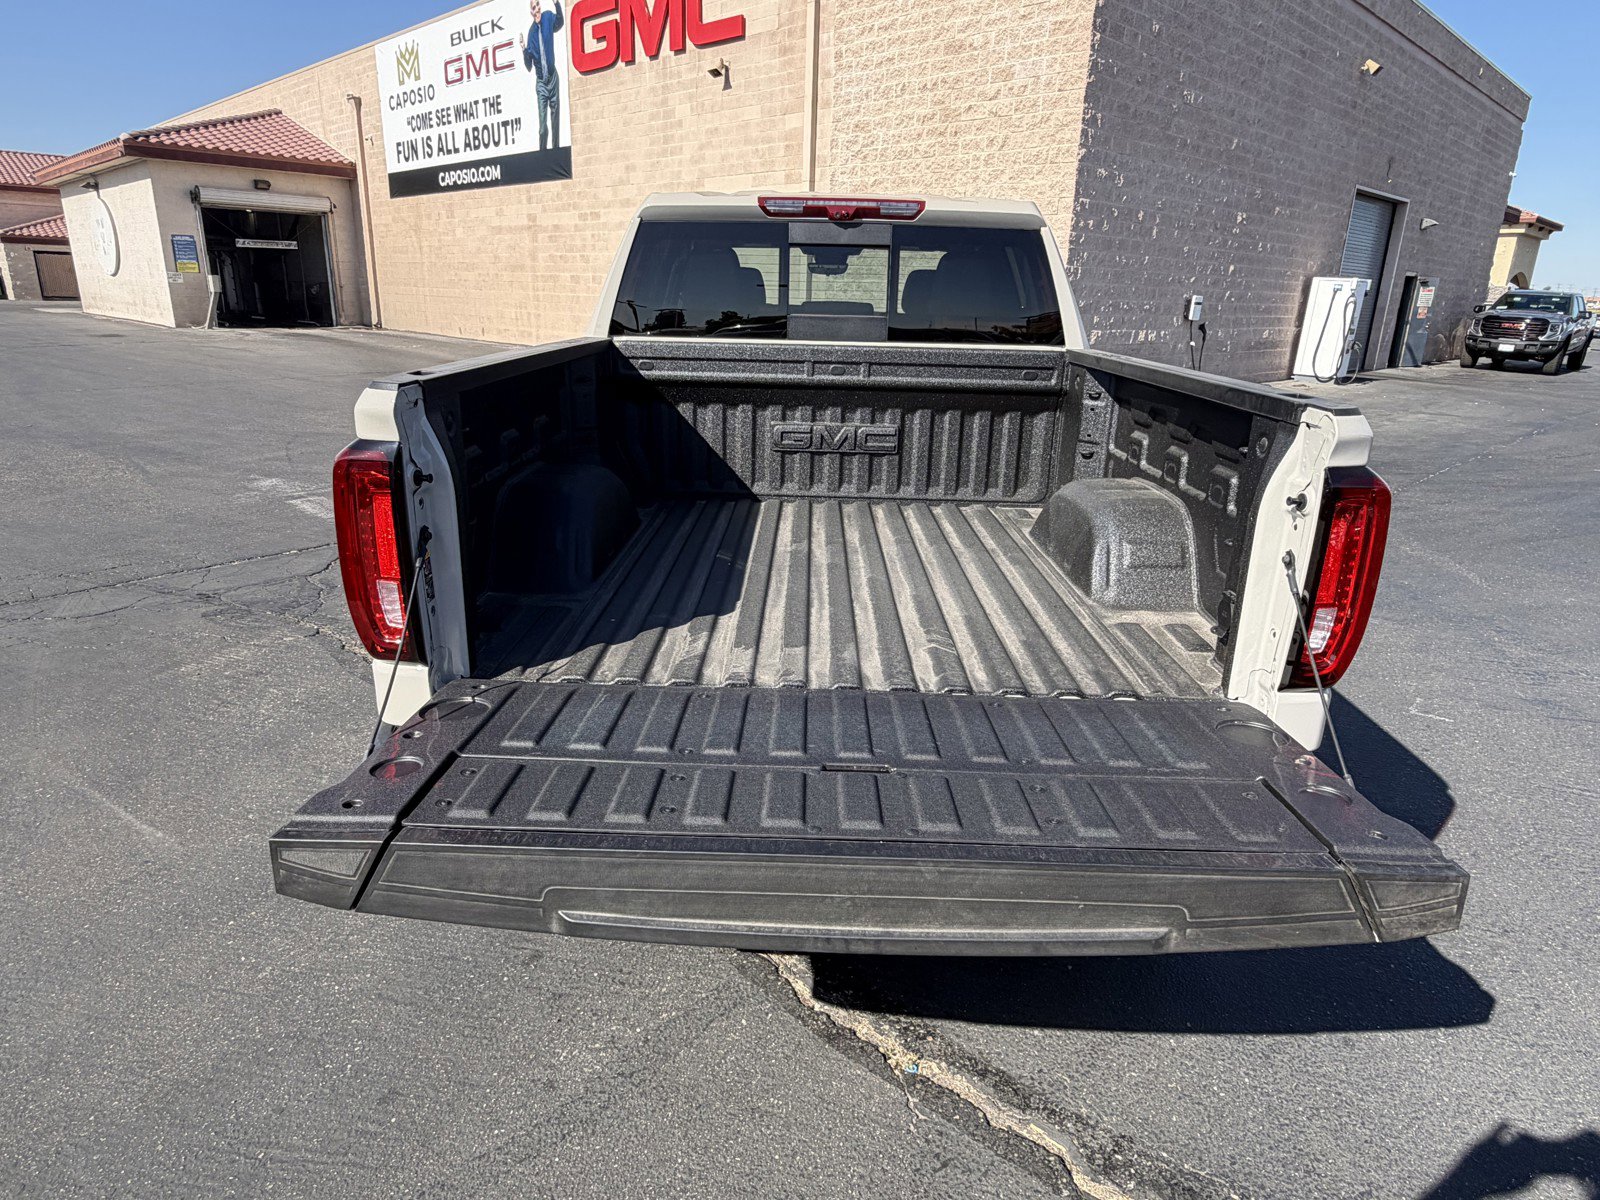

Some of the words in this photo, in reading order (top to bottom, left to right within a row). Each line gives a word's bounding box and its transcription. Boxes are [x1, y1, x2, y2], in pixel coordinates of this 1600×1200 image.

[450, 16, 505, 47] BUICK
[571, 0, 744, 73] GMC
[444, 38, 516, 87] GMC
[388, 84, 435, 111] CAPOSIO
[435, 106, 452, 127] SEE
[453, 100, 479, 123] WHAT
[482, 94, 502, 117] THE
[396, 135, 419, 163] FUN
[422, 135, 432, 159] IS
[437, 130, 461, 157] ALL
[438, 164, 501, 187] CAPOSIO.COM
[772, 424, 898, 452] GMC
